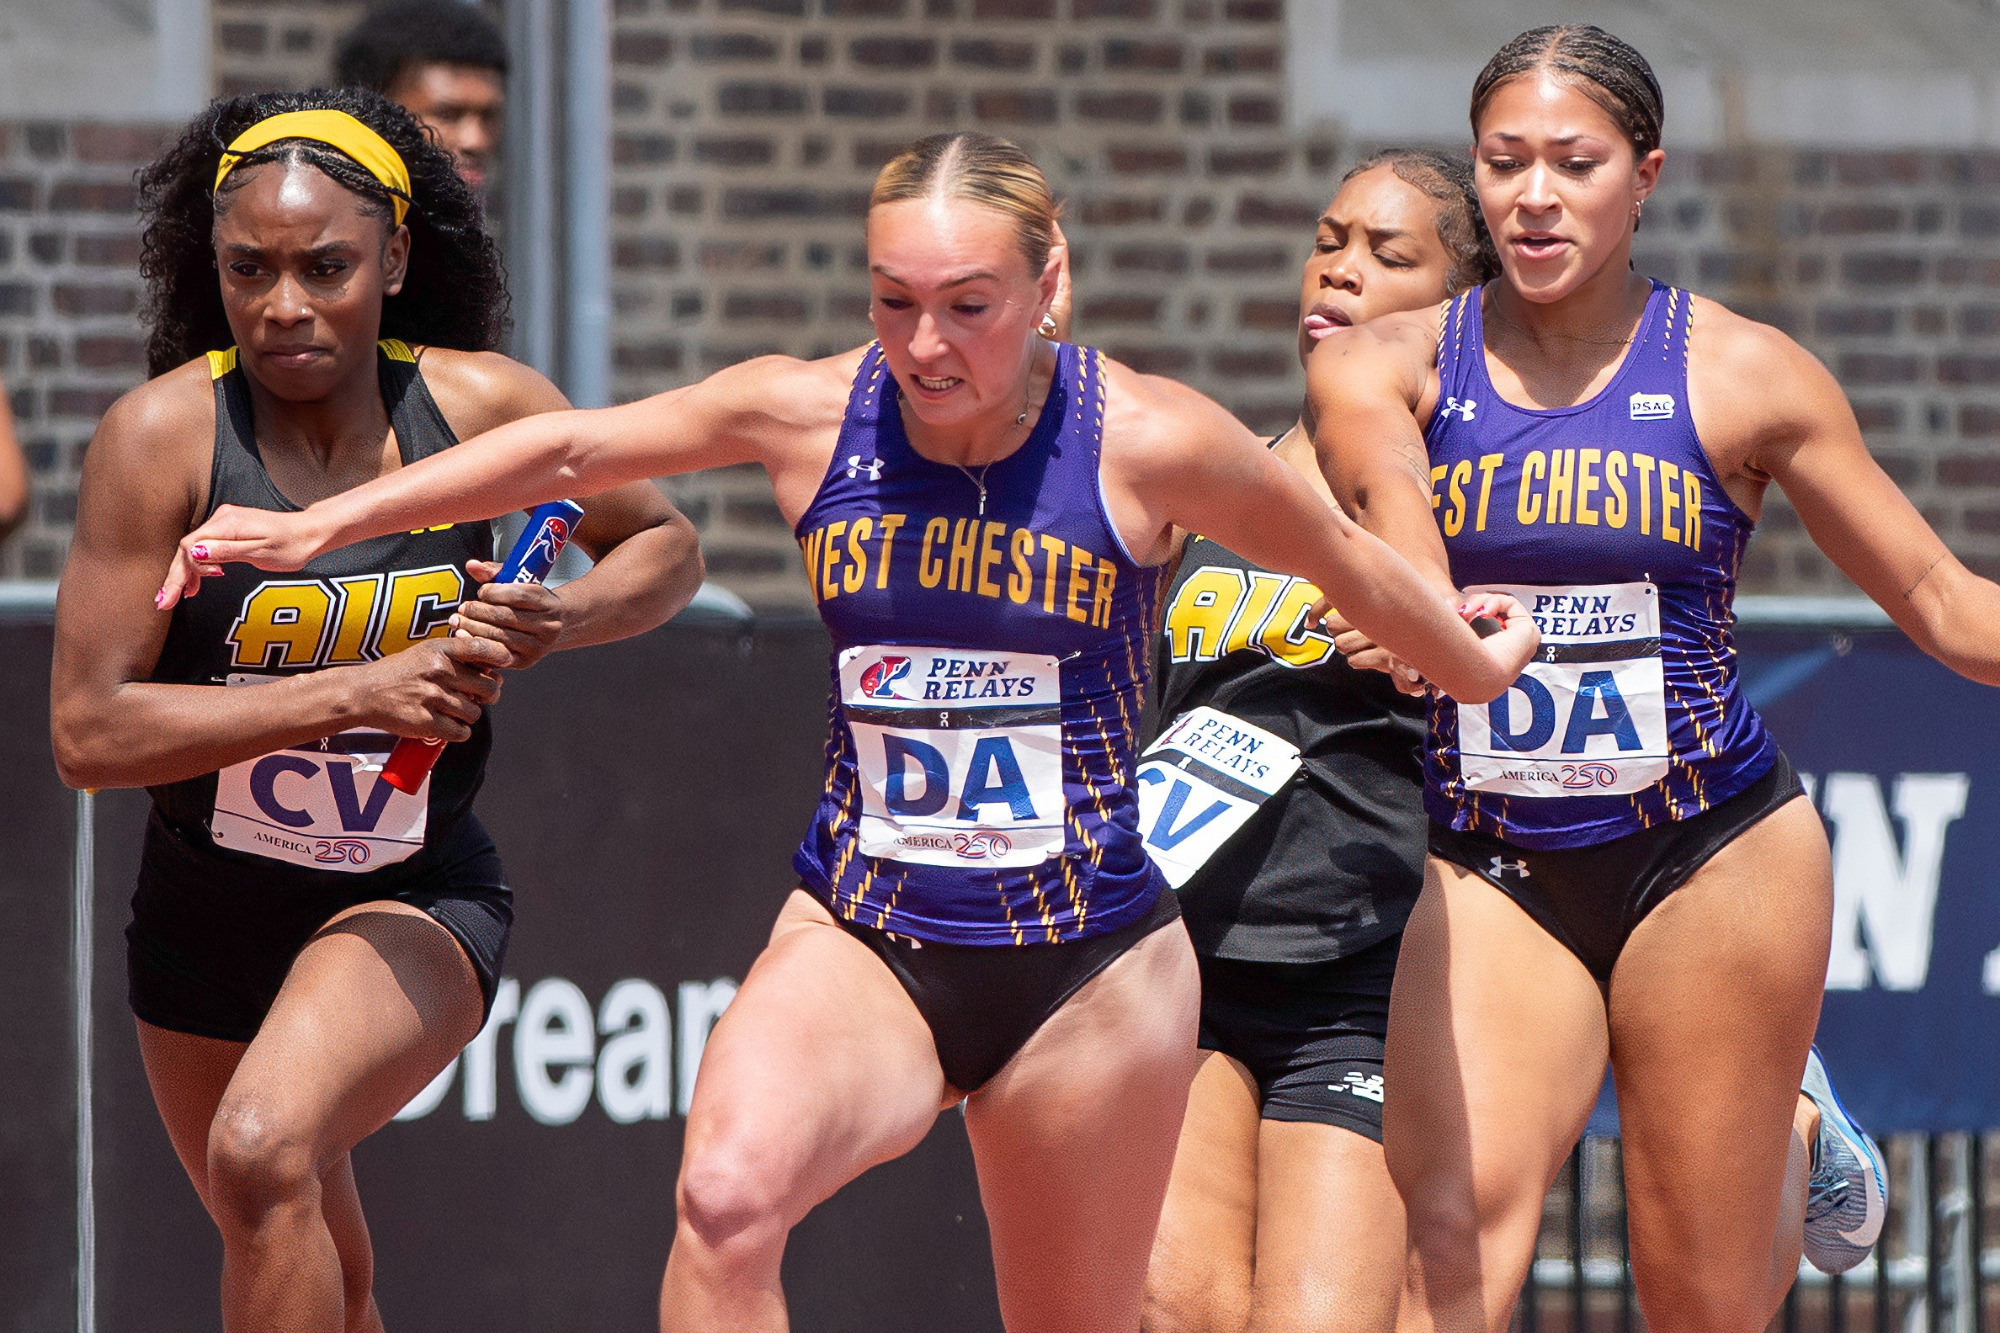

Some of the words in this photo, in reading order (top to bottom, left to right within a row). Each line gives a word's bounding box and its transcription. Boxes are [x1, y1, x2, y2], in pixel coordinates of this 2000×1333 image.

[1430, 452, 1504, 538] EST
[1517, 448, 1702, 553] CHESTER
[918, 516, 1118, 630] CHESTER
[225, 563, 465, 668] AIC
[1164, 565, 1337, 669] AIC
[1532, 594, 1612, 614] PENN
[1534, 613, 1637, 637] RELAYS
[922, 676, 1036, 701] RELAYS
[927, 657, 1011, 678] PENN
[1198, 718, 1264, 754] PENN
[1488, 669, 1644, 755] DA
[882, 732, 1040, 823] DA
[1183, 732, 1270, 780] RELAYS
[1500, 771, 1560, 783] AMERICA
[1560, 762, 1618, 789] 250
[249, 754, 396, 833] CV
[253, 831, 312, 855] AMERICA
[313, 839, 371, 865] 250
